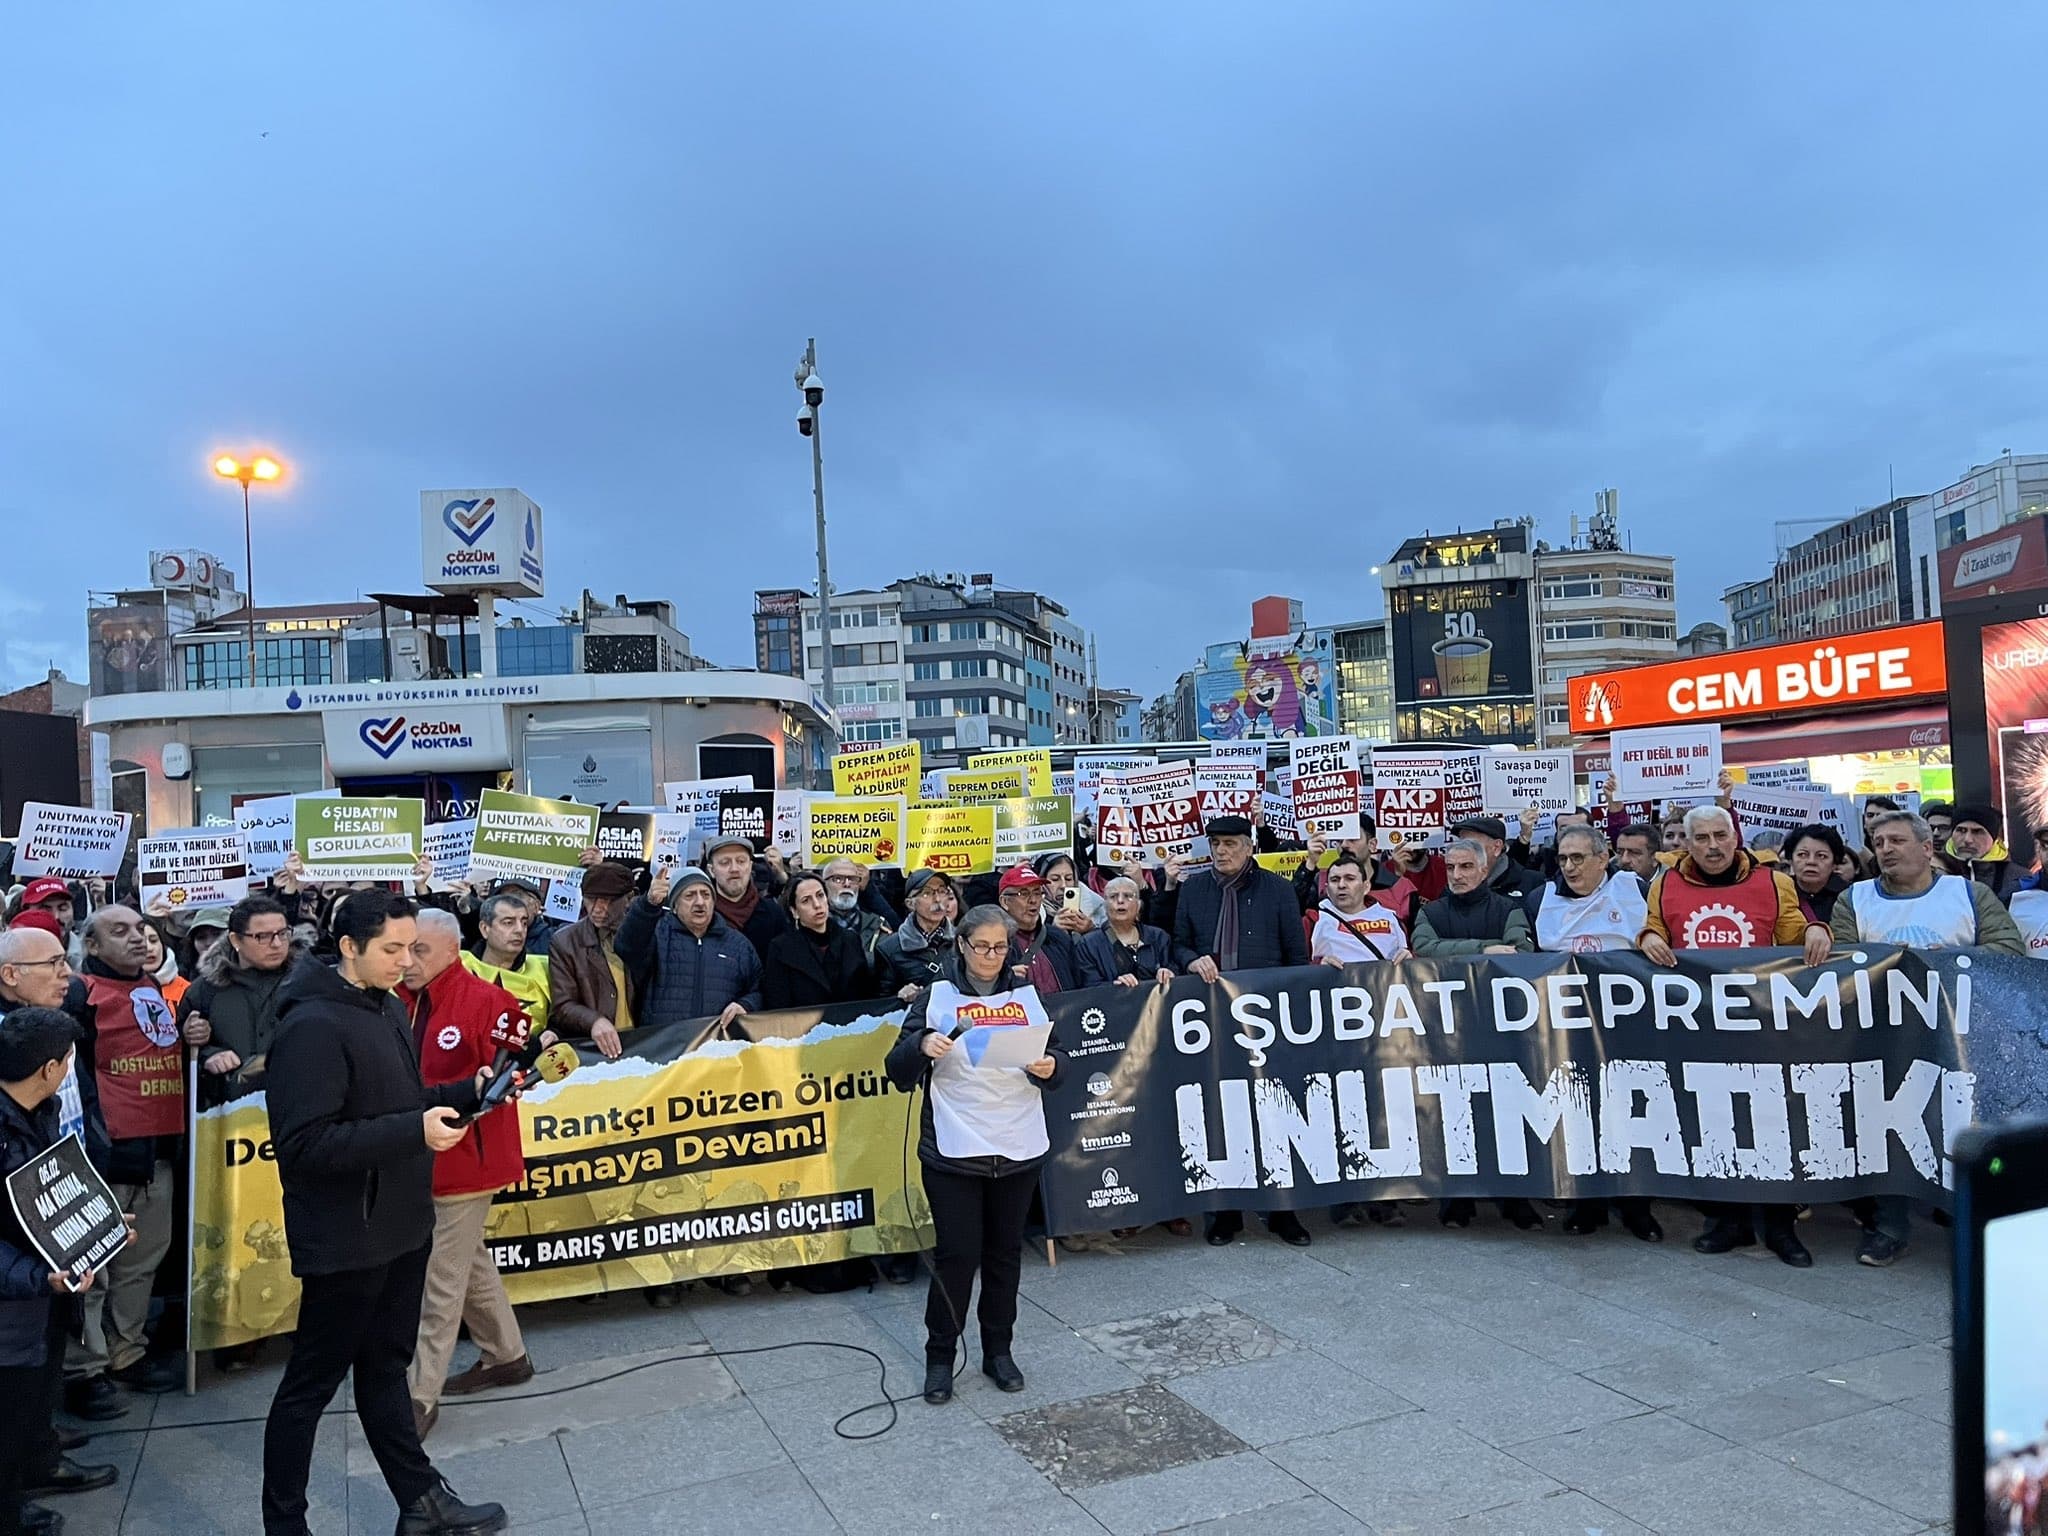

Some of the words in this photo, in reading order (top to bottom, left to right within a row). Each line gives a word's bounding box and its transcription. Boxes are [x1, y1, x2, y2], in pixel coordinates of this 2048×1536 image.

[446, 549, 495, 564] ÇÖZÜM
[442, 565, 500, 577] NOKTASI
[1444, 611, 1476, 639] 50
[1667, 668, 1763, 714] CEM
[1776, 646, 1913, 702] BÜFE
[308, 693, 371, 705] İSTANBUL
[376, 688, 459, 701] BÜYÜKŞEHİR
[465, 685, 539, 697] BELEDİYESİ
[410, 721, 462, 737] ÇÖZÜM
[412, 736, 473, 750] NOKTASI
[847, 743, 880, 752] NOTER
[1295, 741, 1351, 760] DEPREM
[838, 754, 886, 770] DEPREM
[887, 744, 916, 762] DEĞİL
[973, 756, 1013, 768] DEPREM
[1015, 750, 1045, 763] DEĞİL
[1216, 747, 1262, 757] DEPREM
[1623, 750, 1644, 762] AFET
[1647, 746, 1674, 761] DEĞİL
[1676, 747, 1690, 758] BU
[1692, 744, 1709, 758] BİR
[847, 763, 911, 783] KAPİTALİZM
[1297, 755, 1349, 777] DEĞİL
[1377, 769, 1411, 777] ACIMIZ
[1412, 769, 1440, 777] HALA
[1494, 760, 1532, 772] Savaşa
[1641, 763, 1684, 778] KATLİAM
[1199, 773, 1229, 781] ACIMIZ
[1229, 772, 1253, 780] HALA
[1301, 774, 1347, 791] YAĞMA
[1507, 775, 1547, 786] Depreme
[853, 777, 909, 796] ÖLDÜRÜR!
[948, 782, 988, 792] DEPREM
[990, 777, 1020, 790] DEĞİL
[1131, 783, 1162, 795] ACIMIZ
[1163, 778, 1190, 790] HALA
[676, 793, 683, 801] 3
[686, 791, 703, 801] YIL
[1149, 791, 1174, 801] TAZE
[1202, 791, 1250, 809] AKP
[1294, 787, 1355, 806] DÜZENİNİZ
[1381, 789, 1437, 809] AKP
[1512, 787, 1543, 799] BÜTÇE!
[675, 804, 691, 814] NE
[1035, 800, 1059, 812] İNŞA
[1297, 801, 1354, 819] ÖLDÜRDÜ!
[1540, 799, 1568, 810] SODAP
[38, 810, 97, 825] UNUTMAK
[100, 815, 120, 827] YOK
[321, 808, 331, 819] 6
[334, 806, 398, 821] ŞUBAT'IN
[487, 813, 553, 828] UNUTMAK
[722, 807, 764, 821] ASLA
[811, 813, 860, 824] DEPREM
[863, 808, 897, 822] DEĞİL
[1140, 800, 1192, 826] AKP
[1379, 809, 1439, 827] İSTİFA!
[334, 820, 384, 833] HESABI
[722, 819, 765, 829] UNUTMA
[1263, 813, 1298, 830] DEĞİL
[1316, 820, 1344, 832] SEP
[35, 823, 94, 837] AFFETMEK
[97, 828, 117, 839] YOK
[599, 827, 642, 841] ASLA
[811, 825, 881, 839] KAPİTALİZM
[1032, 828, 1063, 838] TALAN
[1142, 821, 1200, 843] İSTİFA!
[1404, 831, 1429, 842] SEP
[33, 835, 112, 851] HELALLEŞMEK
[143, 841, 181, 854] DEPREM,
[183, 839, 221, 852] YANGIN,
[314, 836, 407, 852] SORULACAK!
[483, 830, 552, 846] AFFETMEK
[554, 836, 588, 850] YOK!
[598, 840, 643, 850] UNUTMA
[811, 841, 873, 854] ÖLDÜRÜR!
[31, 848, 60, 860] YOK!
[1168, 843, 1193, 855] SEP
[169, 857, 180, 867] VE
[183, 856, 206, 867] RANT
[209, 852, 240, 864] DÜZENİ
[472, 856, 513, 870] MUNZUR
[514, 863, 546, 877] ÇEVRE
[939, 855, 967, 867] DGB
[166, 869, 224, 884] ÖLDÜRÜYOR!
[343, 867, 375, 878] ÇEVRE
[191, 891, 225, 901] PARTİSİ
[1697, 925, 1739, 943] DİSK
[1171, 999, 1211, 1054] 6
[1230, 980, 1466, 1068] ŞUBAT
[1491, 951, 1973, 1035] DEPREMİNİ
[1081, 1037, 1110, 1048] İSTANBUL
[1087, 1080, 1113, 1093] KESK
[533, 1105, 656, 1142] Rantçı
[668, 1089, 783, 1123] Düzen
[795, 1070, 905, 1106] Öldür
[1098, 1105, 1136, 1117] PLATFORMU
[675, 1117, 823, 1166] Devam!
[1081, 1132, 1132, 1147] tmmob
[38, 1157, 60, 1186] 06.02
[34, 1191, 58, 1221] MA
[50, 1171, 89, 1210] RIHNA,
[1111, 1193, 1139, 1206] ODASI
[537, 1234, 606, 1265] BARIŞ
[610, 1228, 639, 1252] VE
[644, 1206, 771, 1247] DEMOKRASİ
[776, 1194, 864, 1232] GÜÇLERİ
